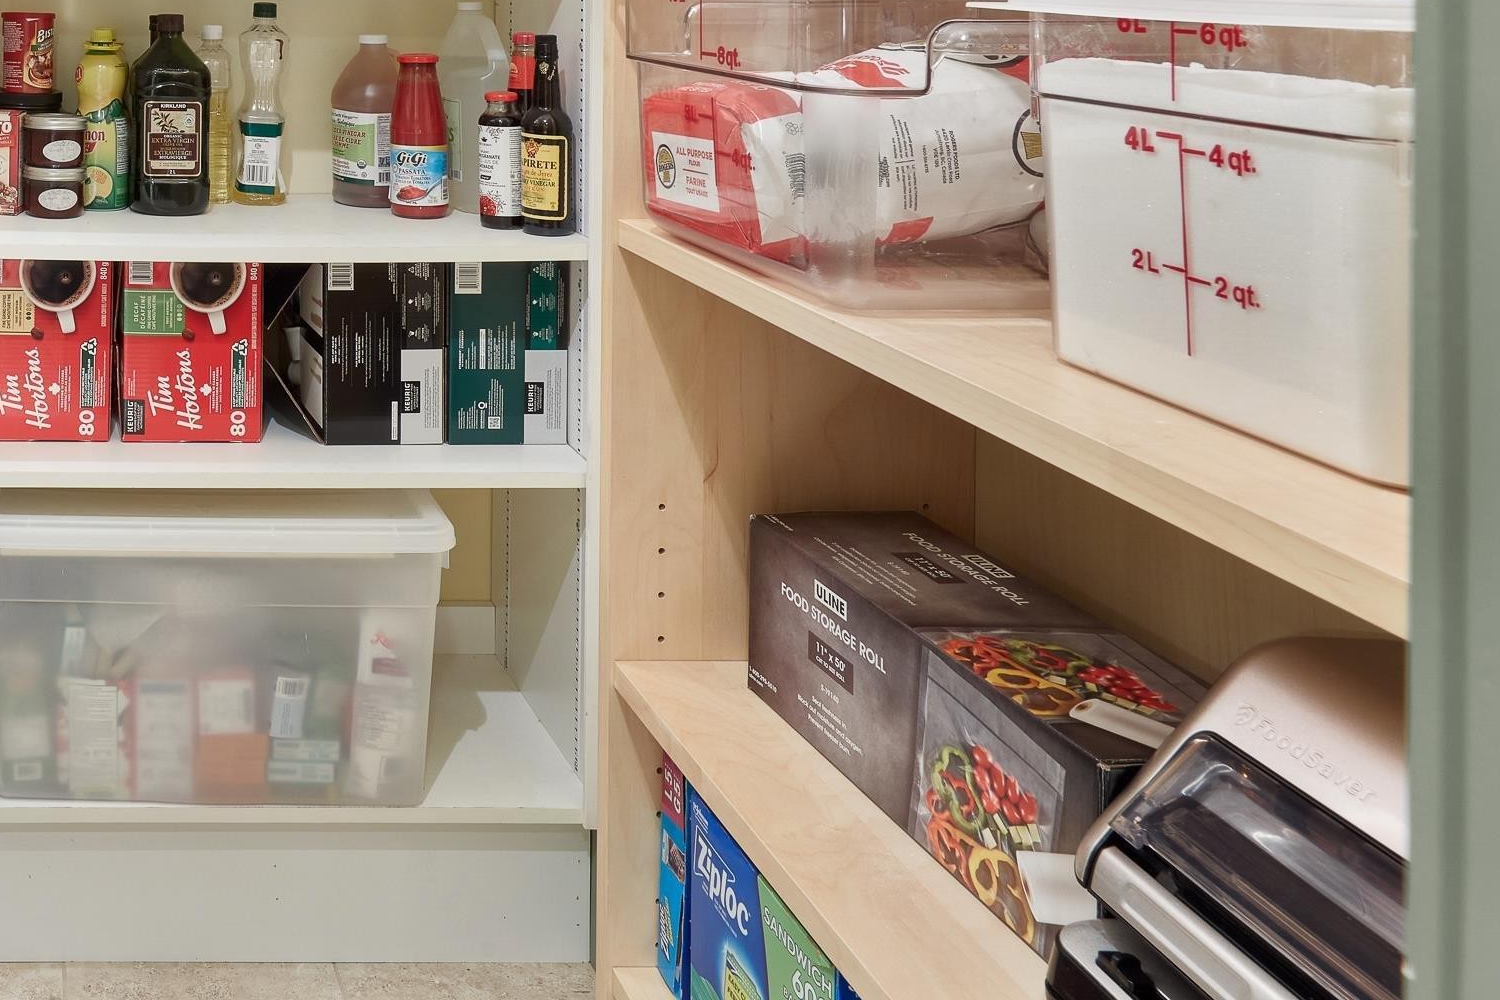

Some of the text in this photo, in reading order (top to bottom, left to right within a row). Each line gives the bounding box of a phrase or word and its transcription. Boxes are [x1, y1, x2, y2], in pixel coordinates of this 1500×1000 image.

[658, 162, 674, 173] ROGERS
[676, 145, 713, 161] ALL PURPOSE
[688, 159, 701, 168] FLOUR
[530, 179, 556, 187] VINEGAR
[685, 175, 707, 188] FARINE
[100, 266, 108, 280] 840
[250, 266, 258, 281] 840
[25, 349, 52, 429] Hortons
[147, 375, 175, 417] Tim
[175, 350, 204, 430] Hortons
[78, 409, 95, 437] 80
[230, 410, 246, 437] 80
[901, 532, 1031, 606] FOOD STORAGE ROLL
[816, 584, 846, 617] ULINE
[781, 581, 887, 675] FOOD STORAGE ROLL
[1256, 717, 1378, 804] FoodSaver
[696, 834, 749, 937] Ziploc
[762, 905, 833, 999] SANDWICH
